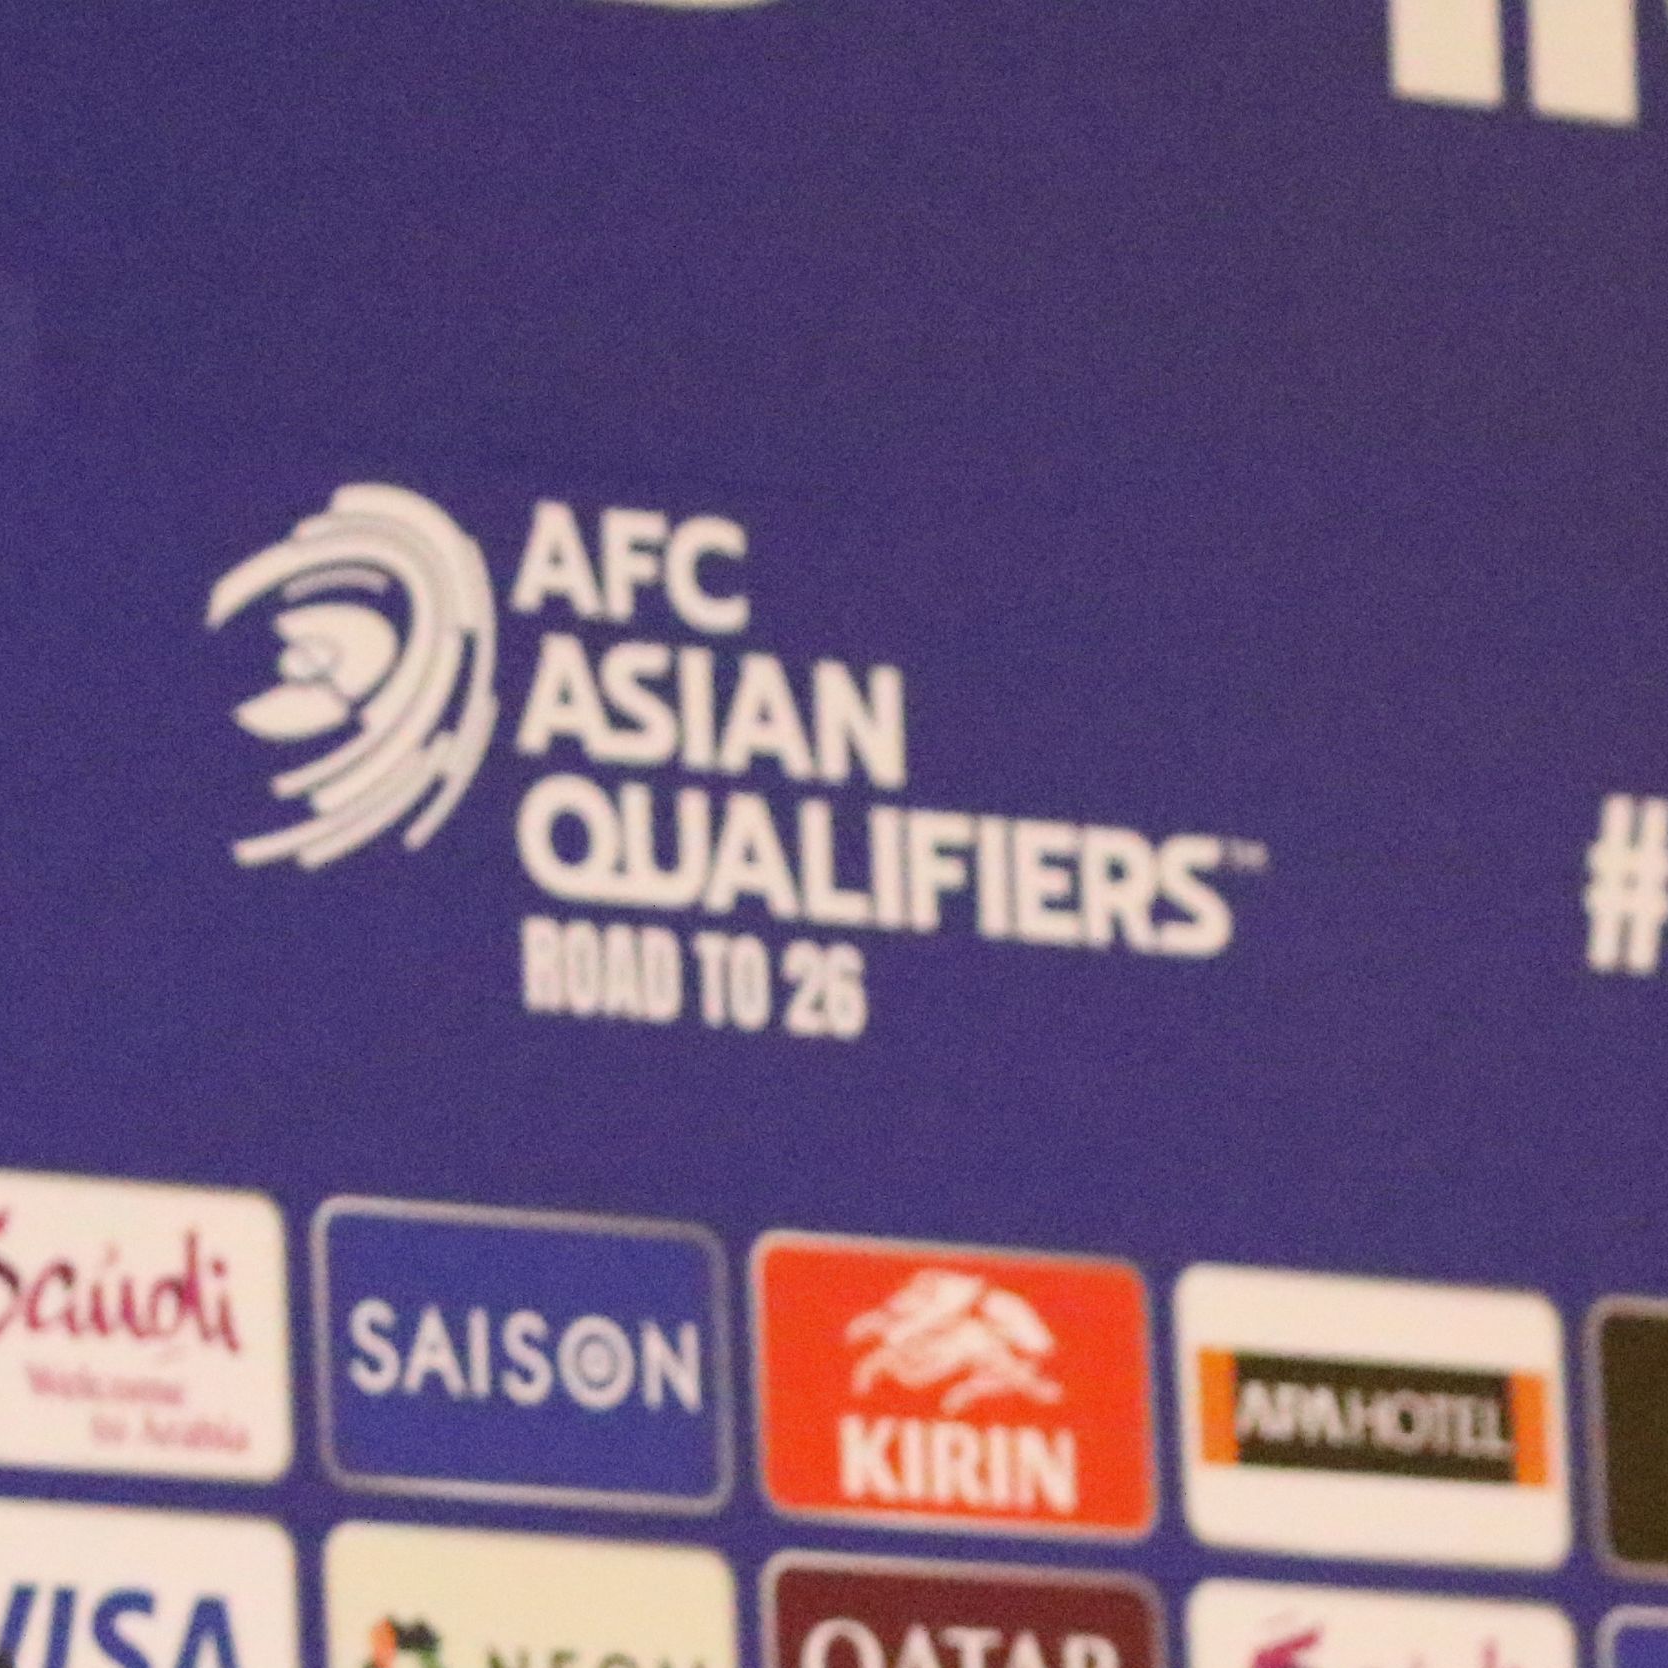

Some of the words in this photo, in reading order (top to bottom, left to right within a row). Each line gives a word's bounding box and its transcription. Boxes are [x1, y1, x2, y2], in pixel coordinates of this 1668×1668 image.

[512, 498, 754, 635] AFC
[516, 630, 910, 790] ASIAN
[522, 916, 682, 1024] ROAD
[692, 930, 772, 1032] TO
[782, 939, 868, 1042] 26
[347, 1297, 703, 1412] SAISON
[838, 1413, 1079, 1515] KIRIN
